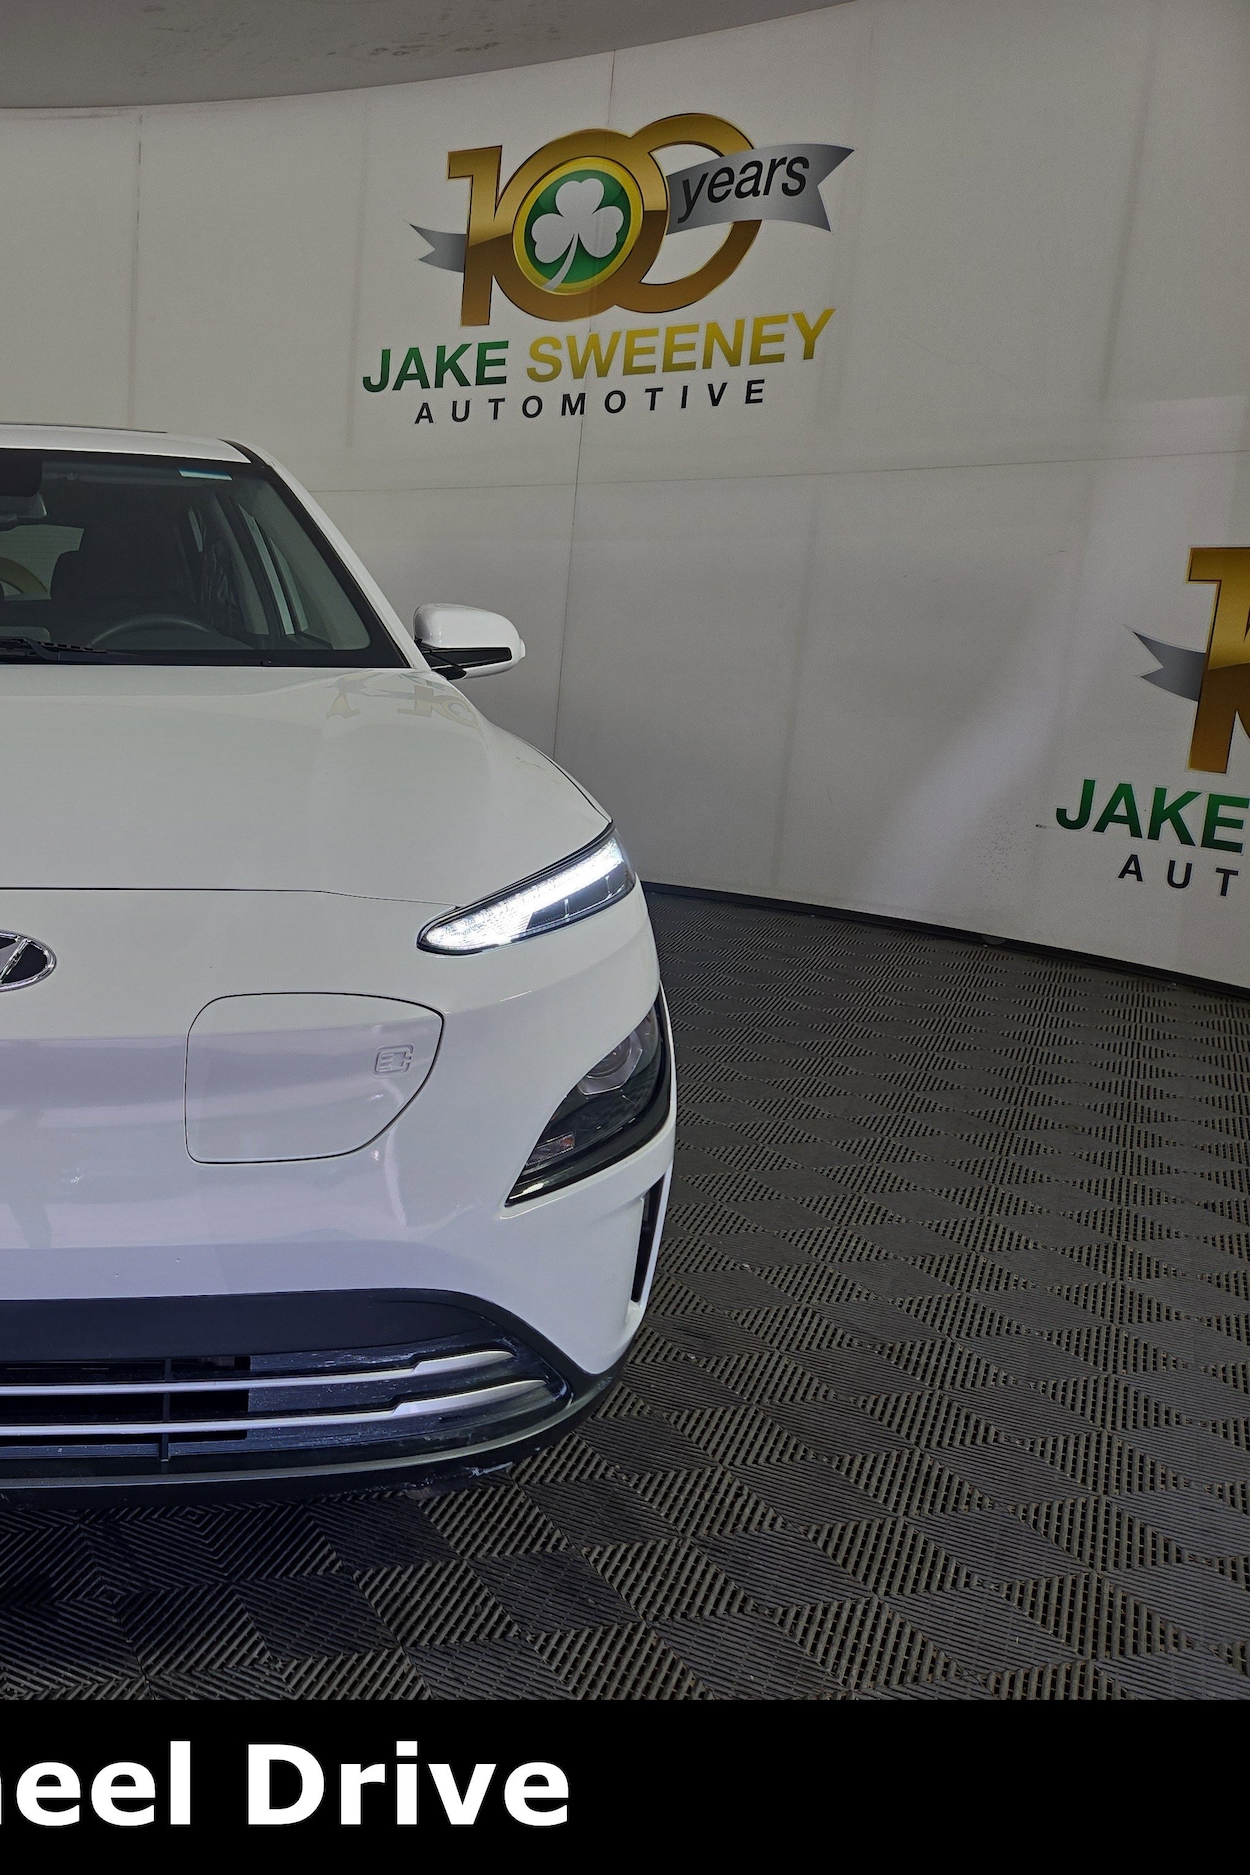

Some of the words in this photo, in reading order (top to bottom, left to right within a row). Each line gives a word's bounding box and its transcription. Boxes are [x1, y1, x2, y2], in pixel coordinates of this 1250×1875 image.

[676, 155, 811, 225] years
[362, 340, 509, 393] JAKE
[525, 308, 837, 383] SWEENEY
[414, 379, 767, 426] AUTOMOTIVE
[1055, 778, 1250, 854] JAKE
